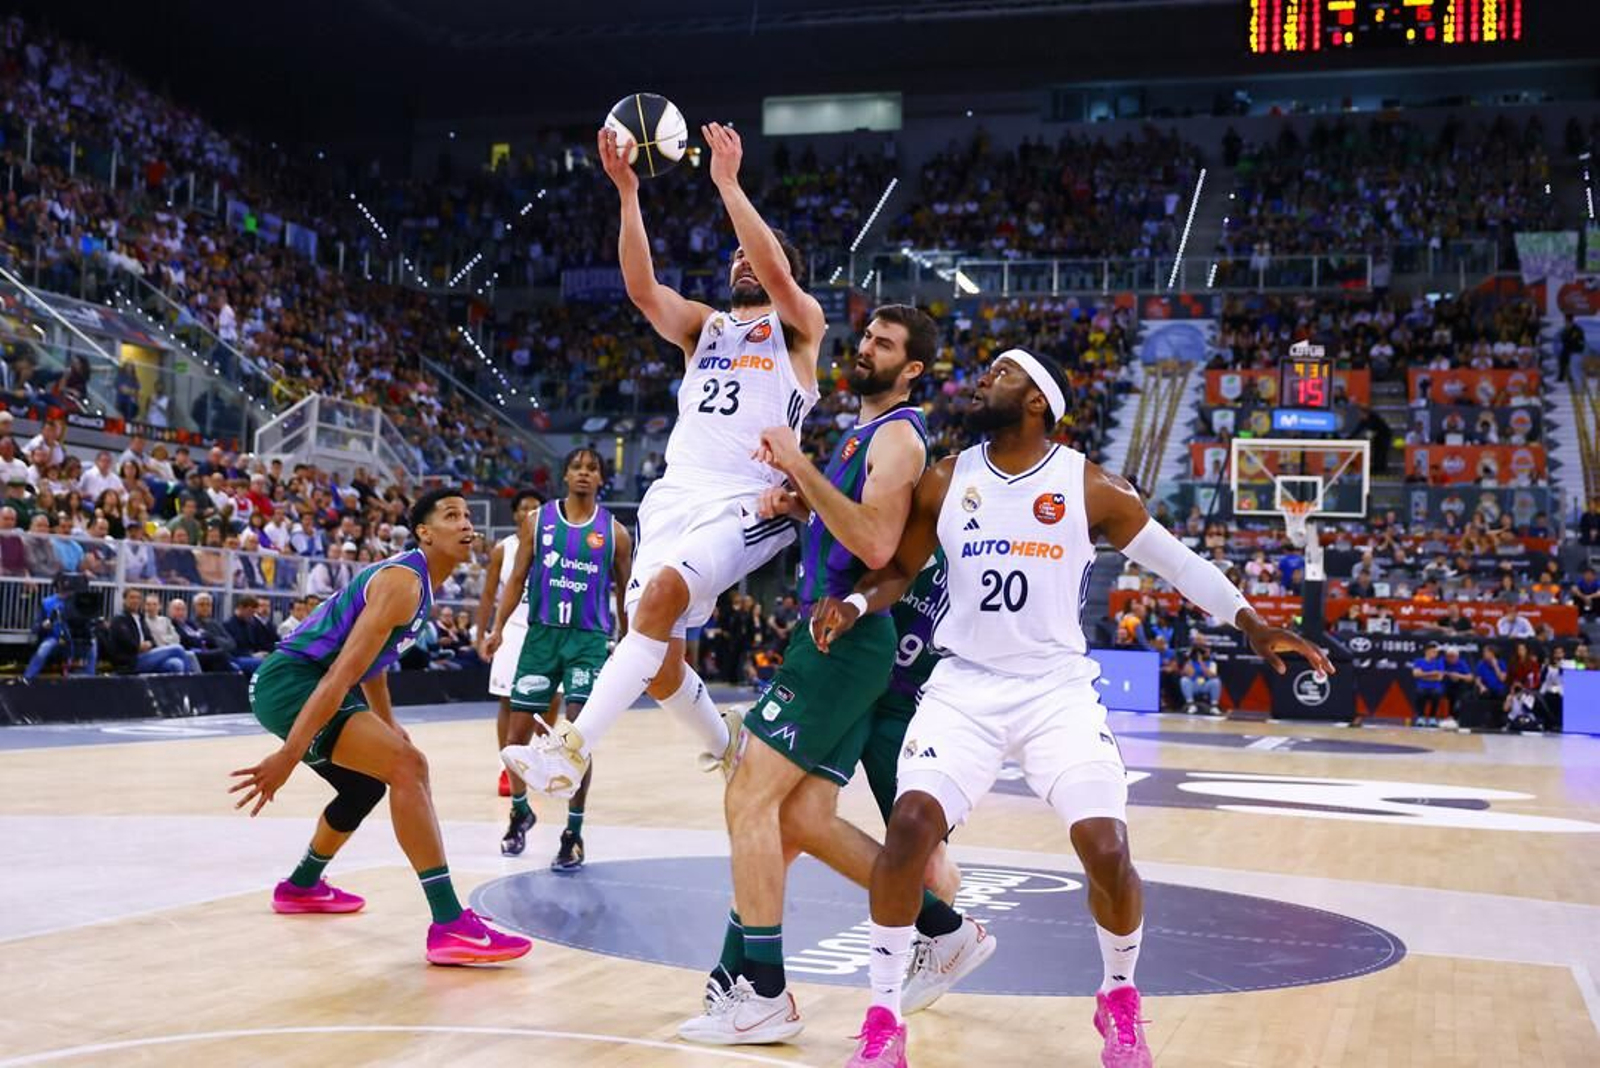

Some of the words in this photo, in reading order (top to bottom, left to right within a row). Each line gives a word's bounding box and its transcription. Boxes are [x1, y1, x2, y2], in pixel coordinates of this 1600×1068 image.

[698, 378, 741, 416] 23
[1298, 378, 1325, 407] 15
[961, 539, 1064, 560] AUTOHERO
[560, 556, 599, 575] Unicaja
[980, 568, 1029, 613] 20
[557, 601, 572, 624] 11
